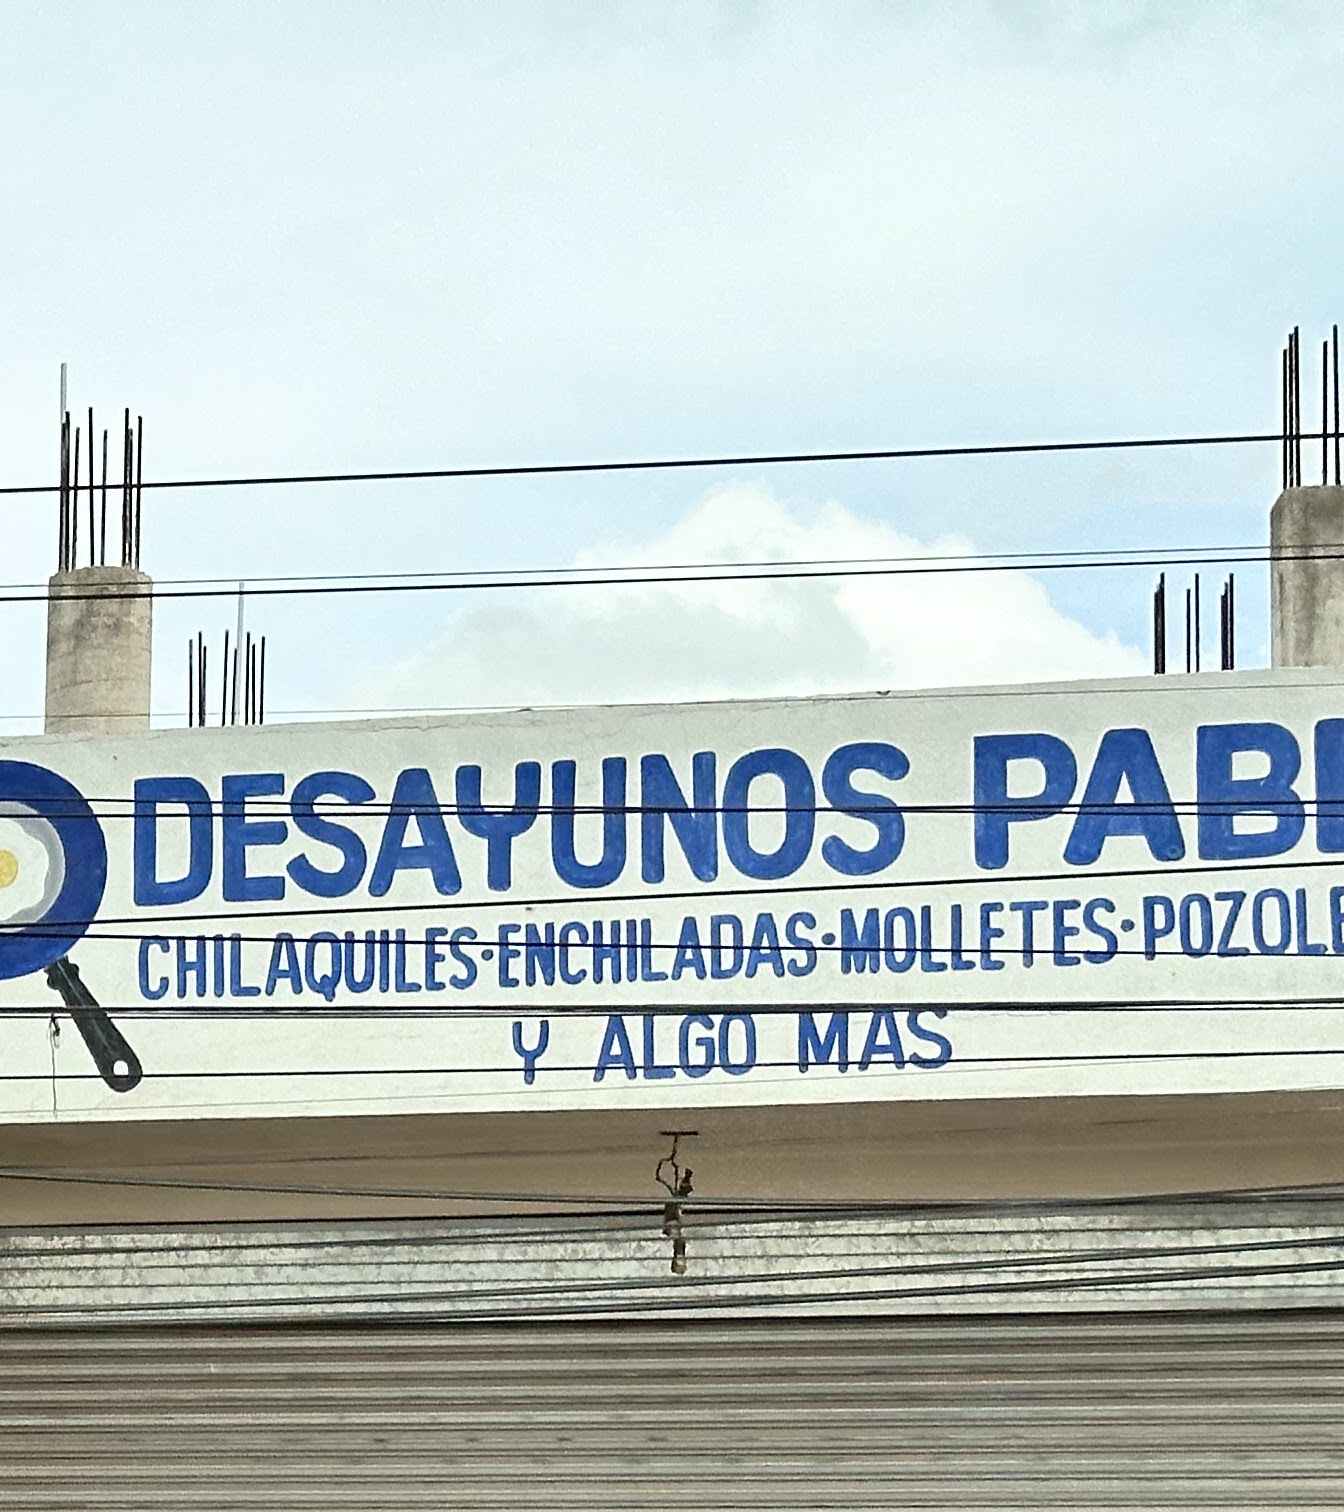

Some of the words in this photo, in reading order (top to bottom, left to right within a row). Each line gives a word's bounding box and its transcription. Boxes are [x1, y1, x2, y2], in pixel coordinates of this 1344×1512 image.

[133, 742, 910, 906] DESAYUNOS
[137, 926, 478, 1001] CHILAQUILES
[498, 911, 817, 988] ENCHILADAS
[840, 899, 1118, 974] MOLLETES
[511, 1019, 550, 1085] Y
[592, 1010, 758, 1082] ALGO
[798, 1006, 952, 1073] MAS
